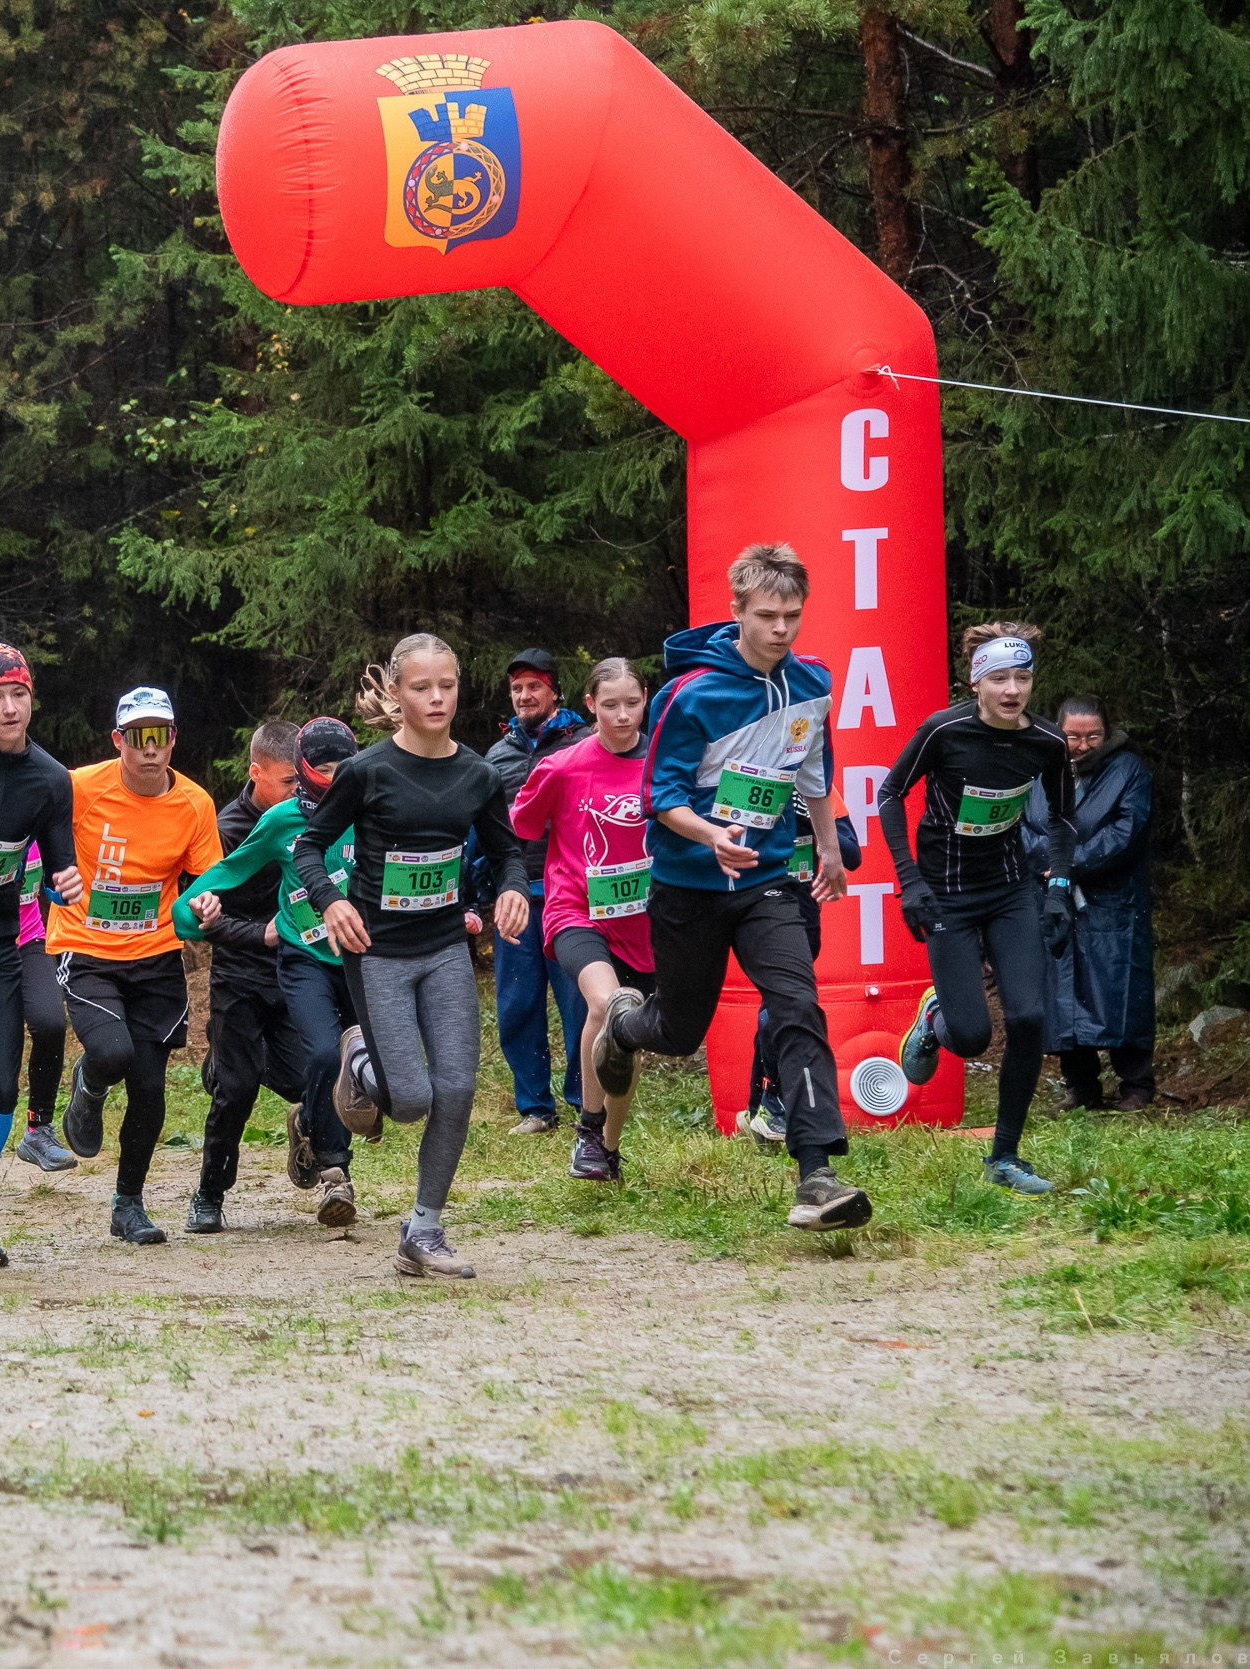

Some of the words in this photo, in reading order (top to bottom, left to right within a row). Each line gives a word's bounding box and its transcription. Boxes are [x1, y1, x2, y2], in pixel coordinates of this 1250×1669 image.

[837, 408, 898, 965] СТАРТ
[786, 745, 807, 754] RUSSIA
[748, 785, 775, 807] 86
[989, 804, 1010, 820] 87
[408, 870, 444, 890] 103
[610, 878, 640, 899] 107
[110, 900, 142, 916] 106
